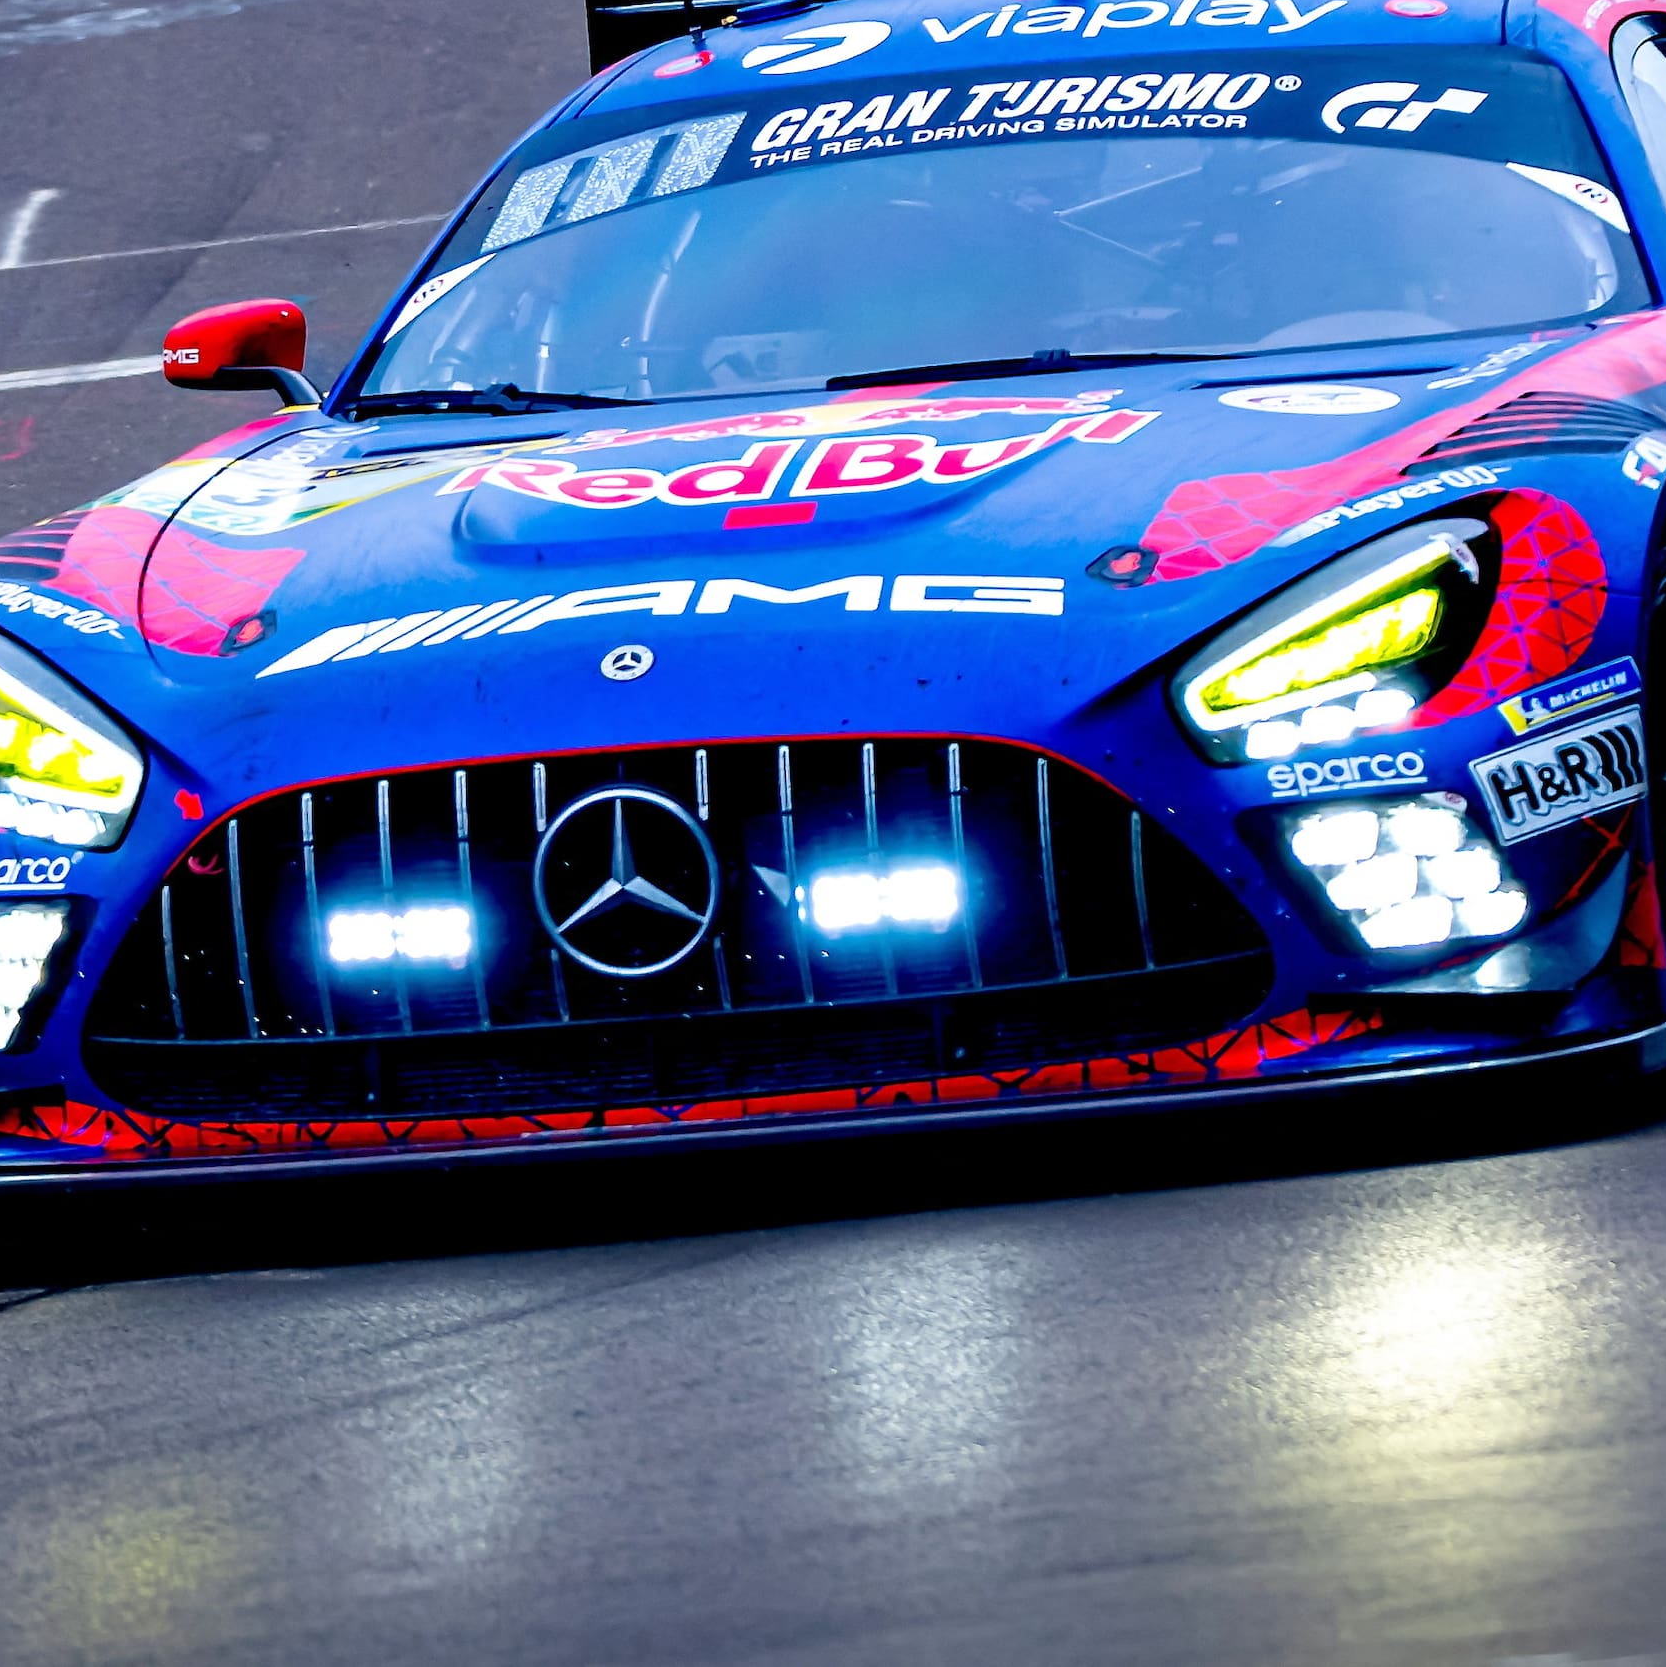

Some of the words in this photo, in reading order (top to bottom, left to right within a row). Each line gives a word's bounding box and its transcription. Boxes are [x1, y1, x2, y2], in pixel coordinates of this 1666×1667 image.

[750, 144, 810, 169] THE
[820, 134, 903, 159] REAL
[910, 120, 1045, 146] DRIVING
[1054, 112, 1247, 134] SIMULATOR
[751, 88, 951, 153] GRAN
[440, 438, 796, 510] Red
[791, 409, 1162, 498] Bull
[498, 574, 1065, 634] AMG
[1549, 671, 1628, 709] MICHELIN
[1267, 750, 1425, 797] sparco
